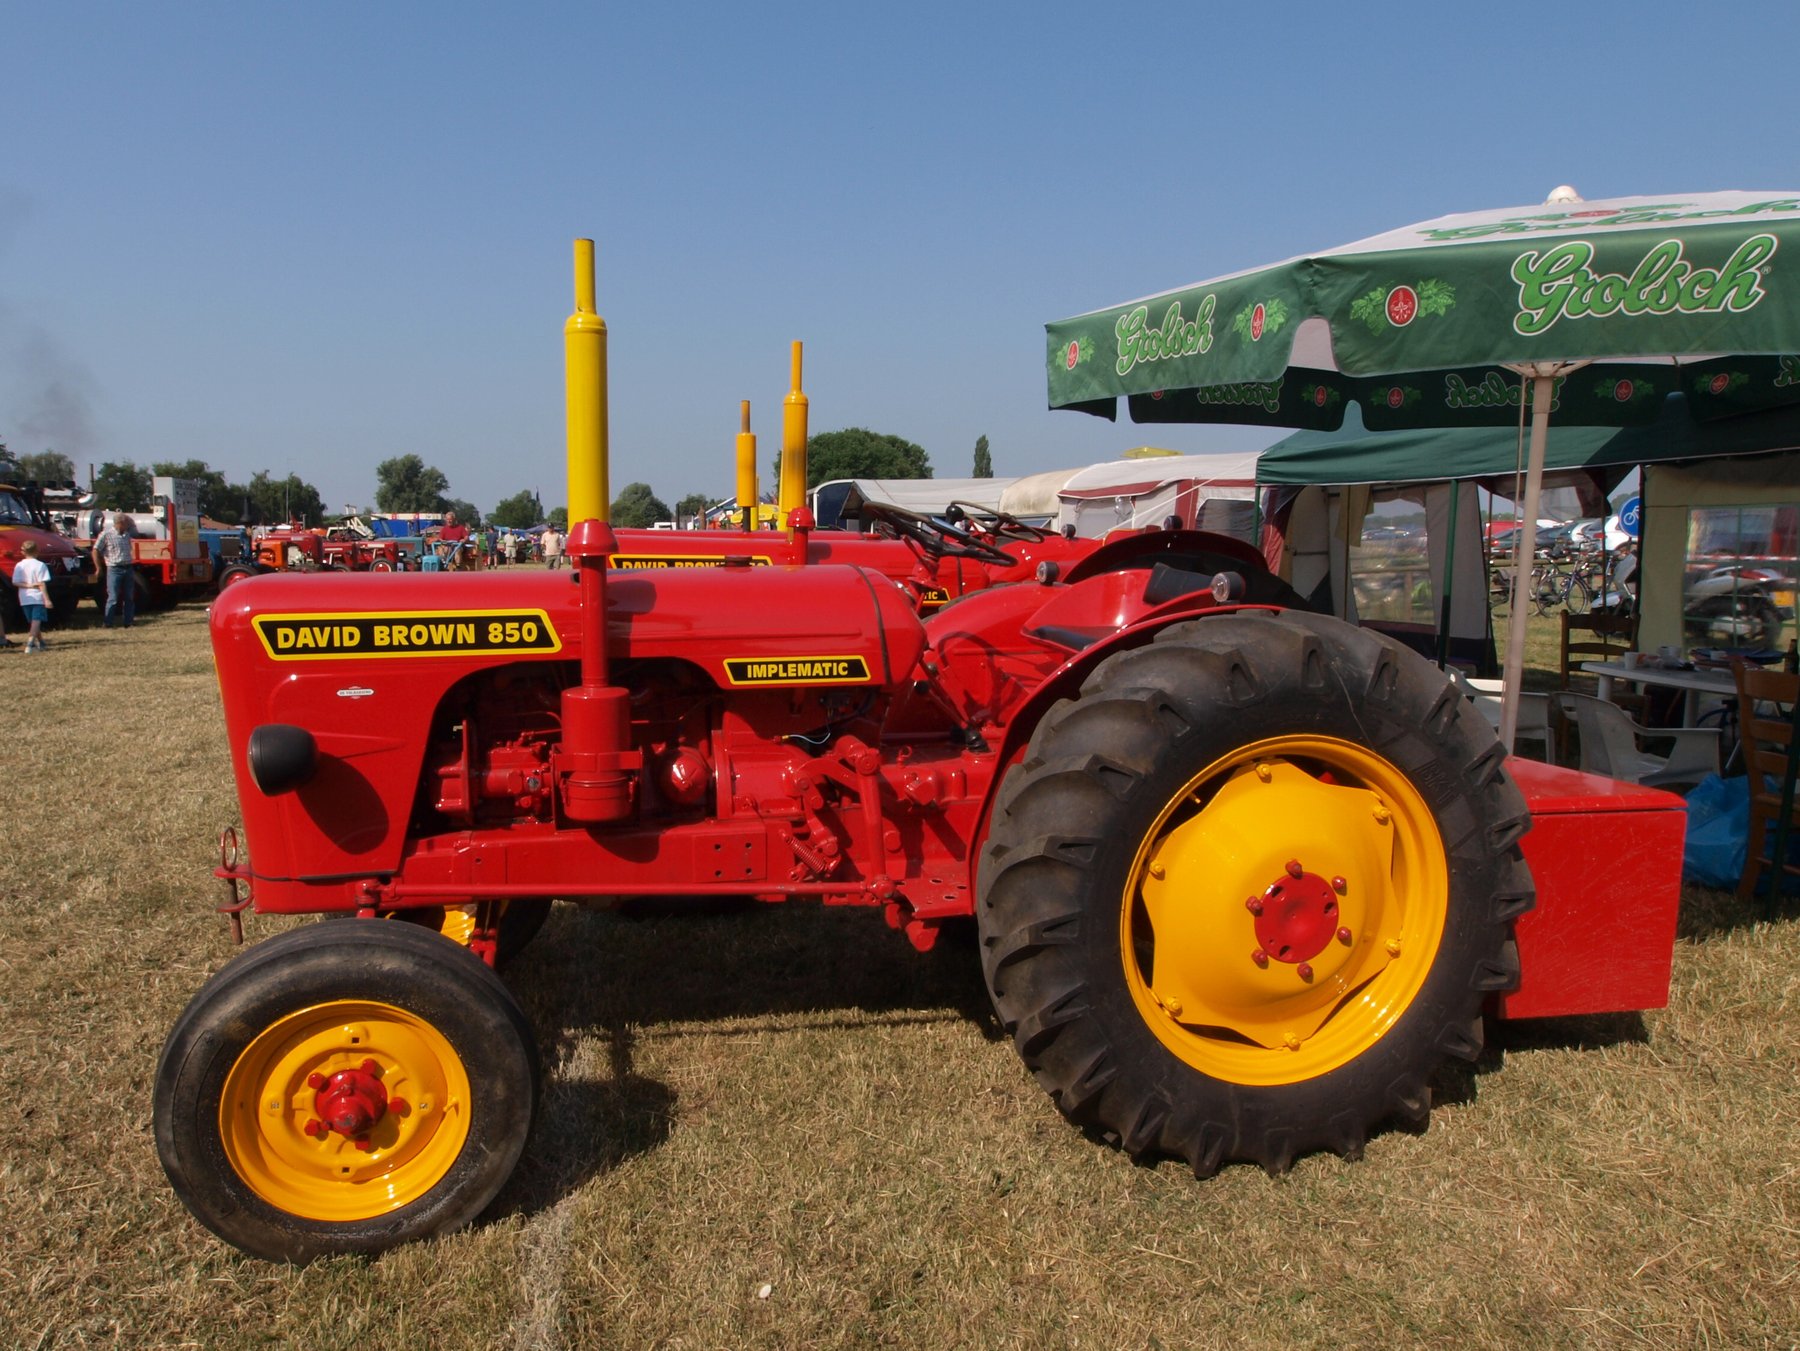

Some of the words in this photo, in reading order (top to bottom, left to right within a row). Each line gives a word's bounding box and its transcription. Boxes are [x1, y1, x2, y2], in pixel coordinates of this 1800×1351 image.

[1511, 233, 1778, 337] Grolsch
[1115, 294, 1216, 375] Grolsch
[276, 626, 361, 649] DAVID
[373, 623, 476, 647] BROWN
[487, 621, 539, 644] 850
[747, 662, 849, 679] IMPLEMATIC
